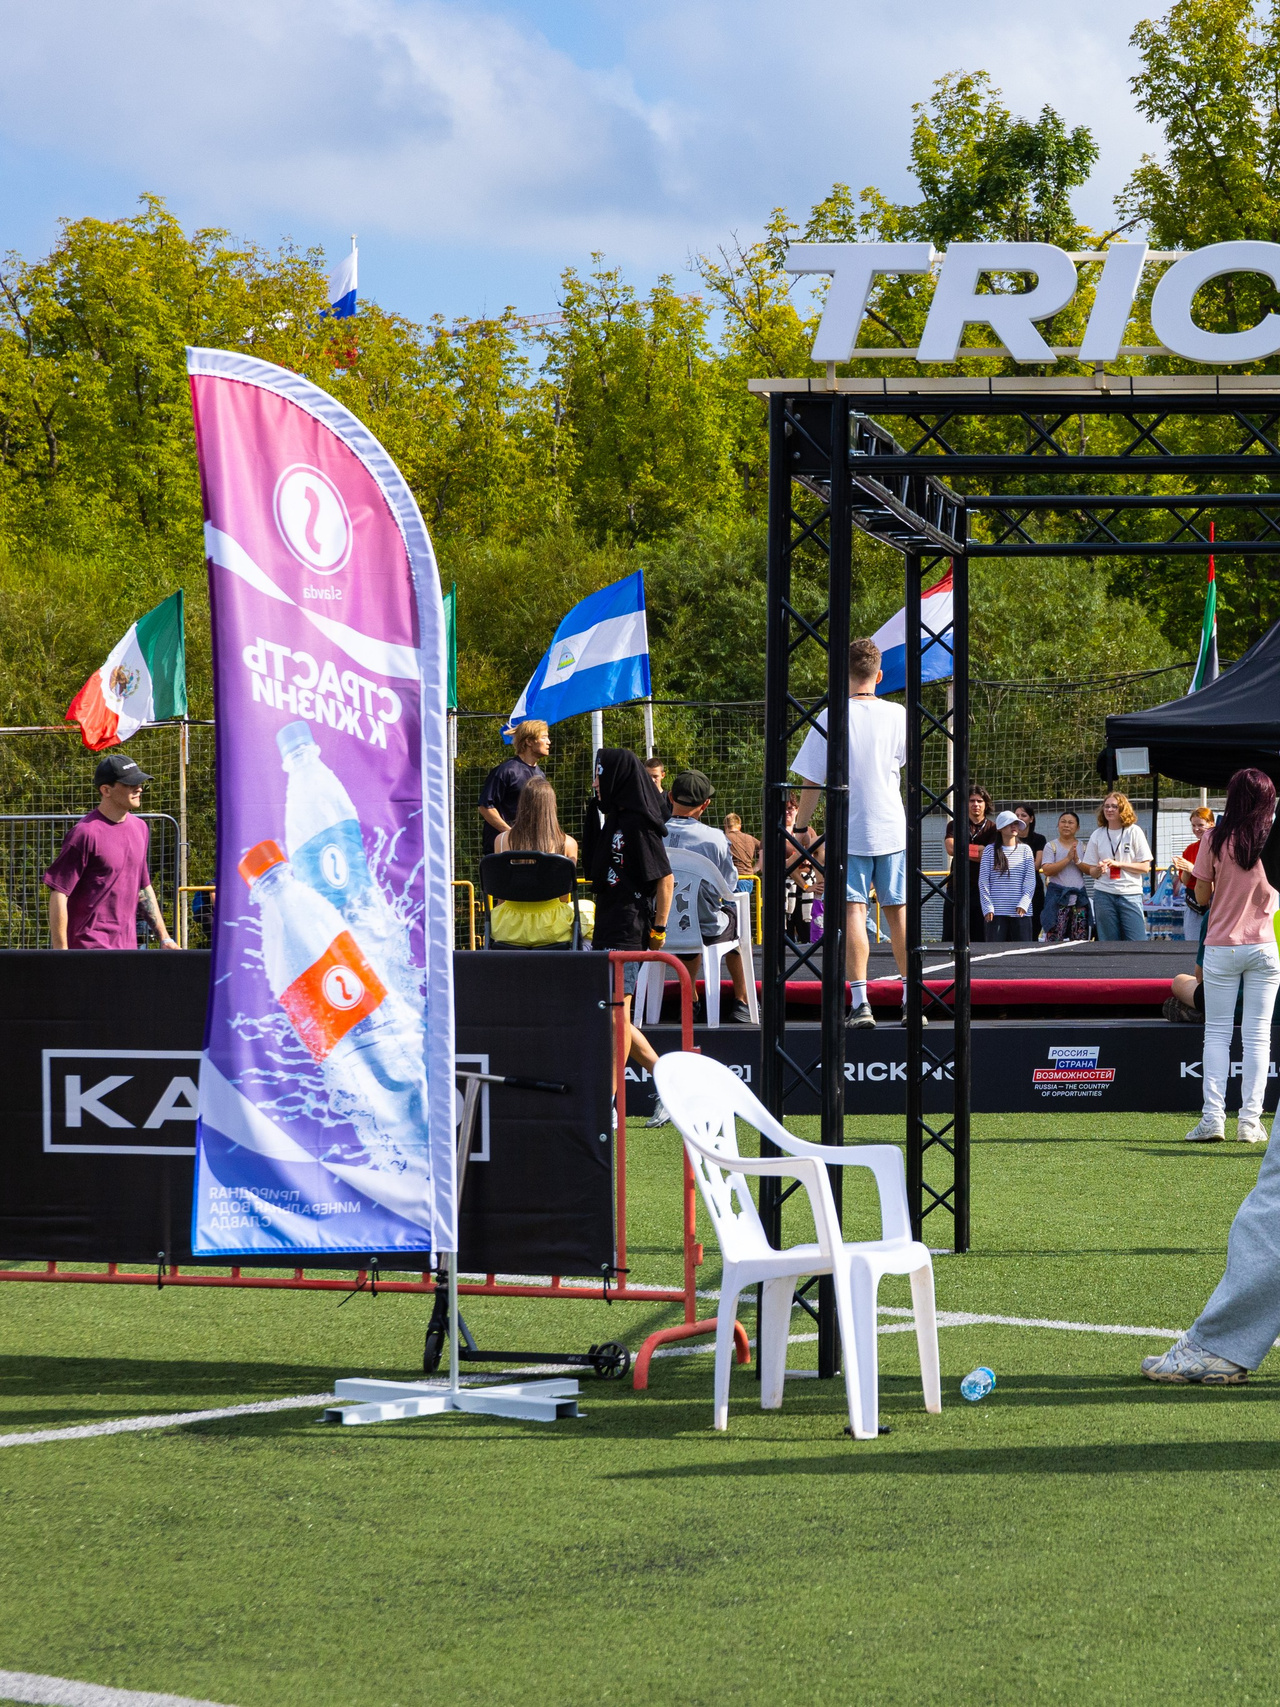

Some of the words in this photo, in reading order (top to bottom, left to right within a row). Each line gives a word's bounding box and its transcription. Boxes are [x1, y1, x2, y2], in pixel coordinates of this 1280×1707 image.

[1051, 1049, 1088, 1057] РОССИЯ
[1058, 1060, 1094, 1069] СТРАНА
[1036, 1070, 1112, 1080] ВОЗМОЖНОСТЕЙ
